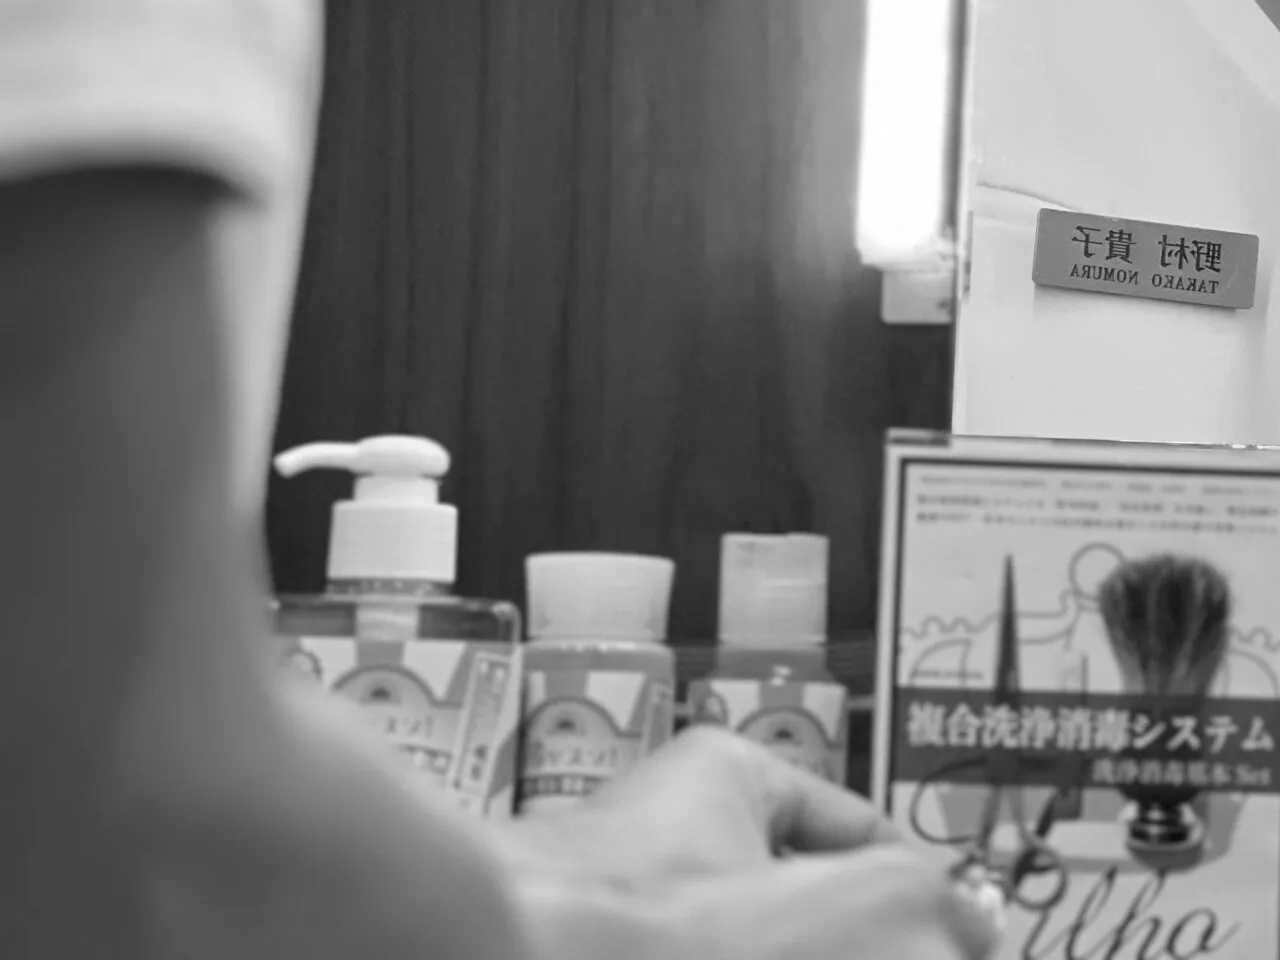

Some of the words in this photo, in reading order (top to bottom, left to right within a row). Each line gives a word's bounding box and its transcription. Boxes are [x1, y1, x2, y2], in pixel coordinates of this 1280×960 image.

[905, 699, 1276, 755] 複合洗浄消毒システム
